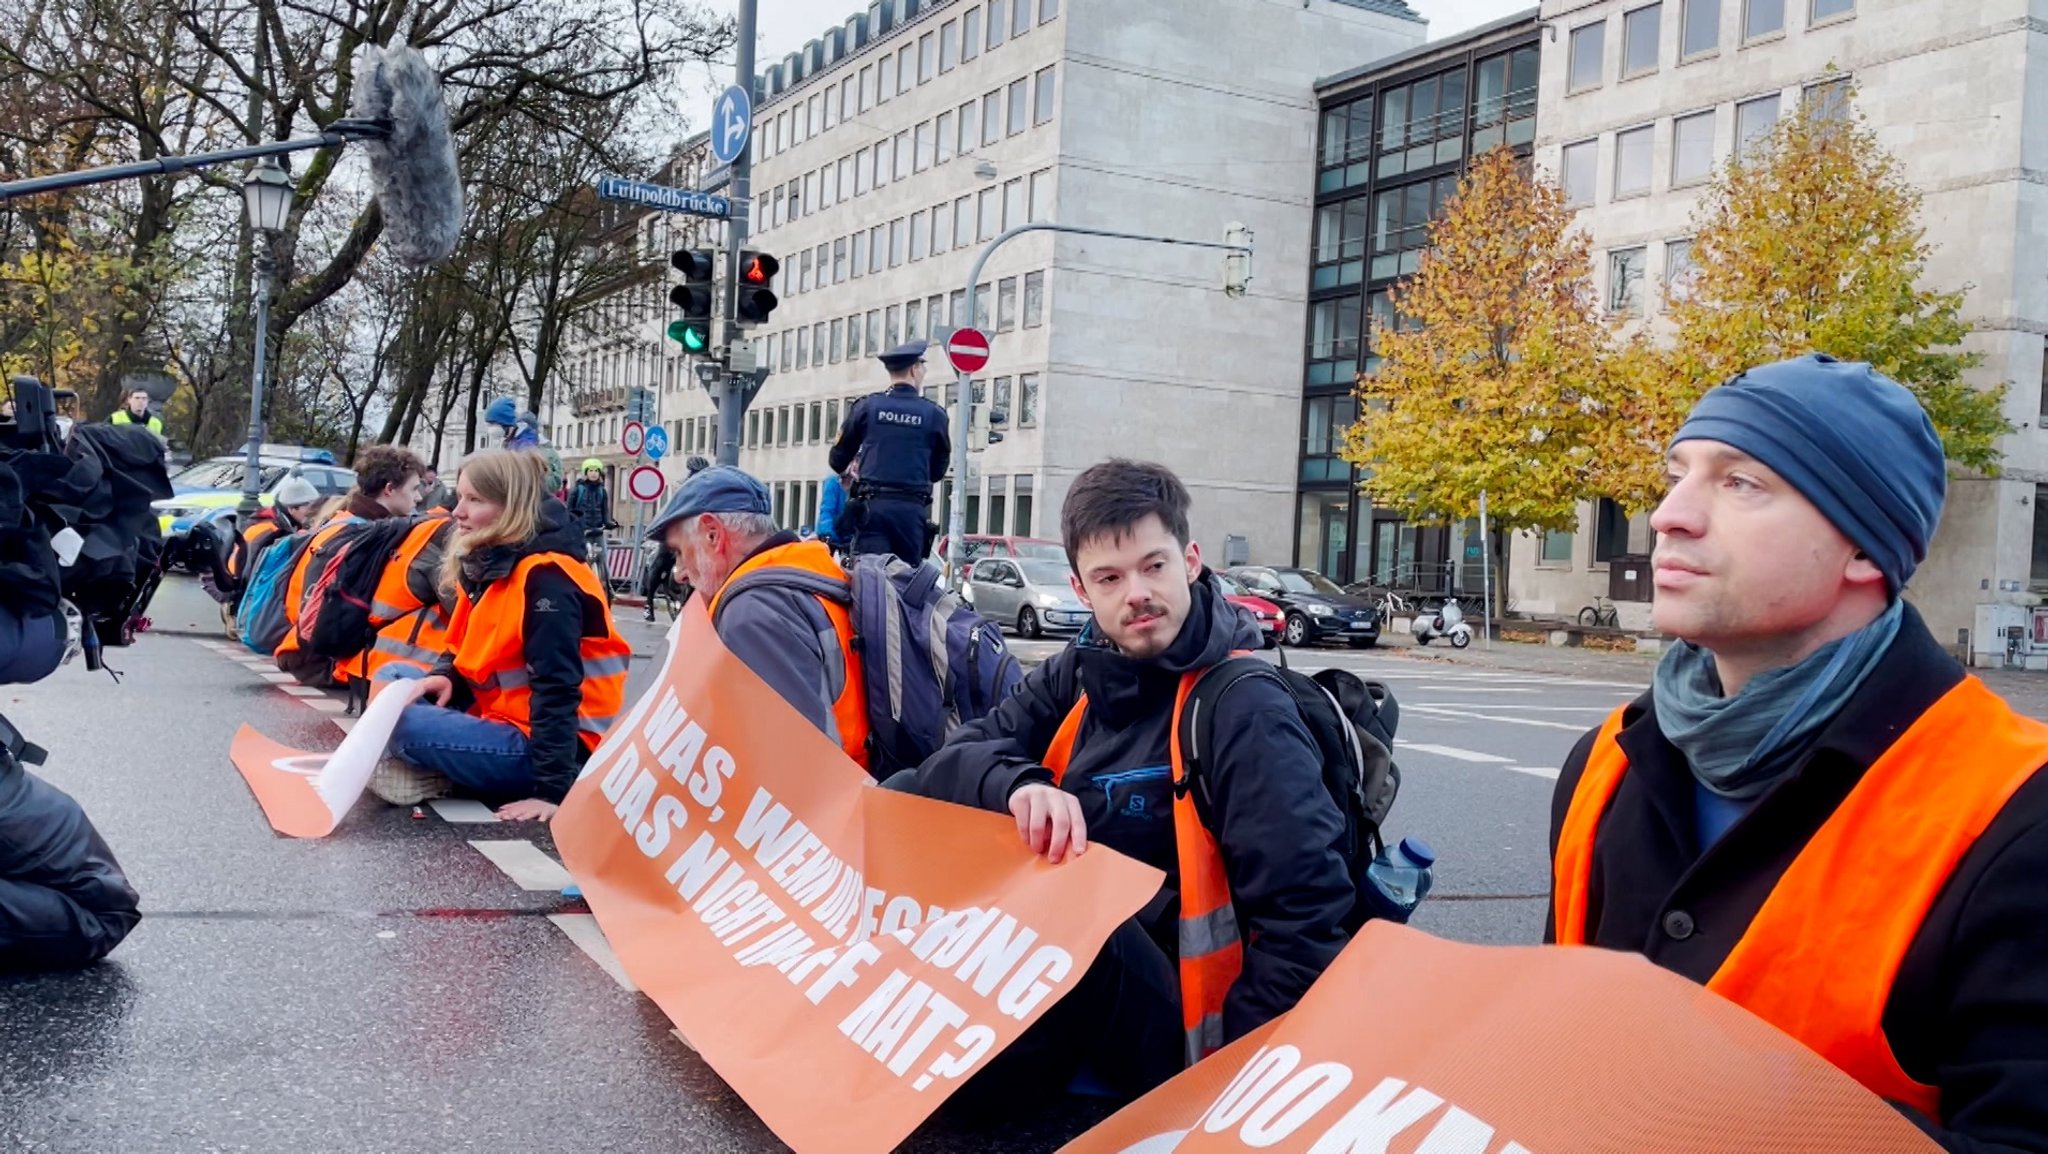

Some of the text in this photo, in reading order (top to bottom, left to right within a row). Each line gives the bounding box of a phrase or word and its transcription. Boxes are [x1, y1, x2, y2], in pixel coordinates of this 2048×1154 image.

[607, 180, 724, 215] Luitpoldbrücke
[878, 411, 922, 425] POLIZEI
[643, 685, 736, 823] WAS,
[600, 741, 688, 858] DAS
[665, 830, 787, 947] NICHT
